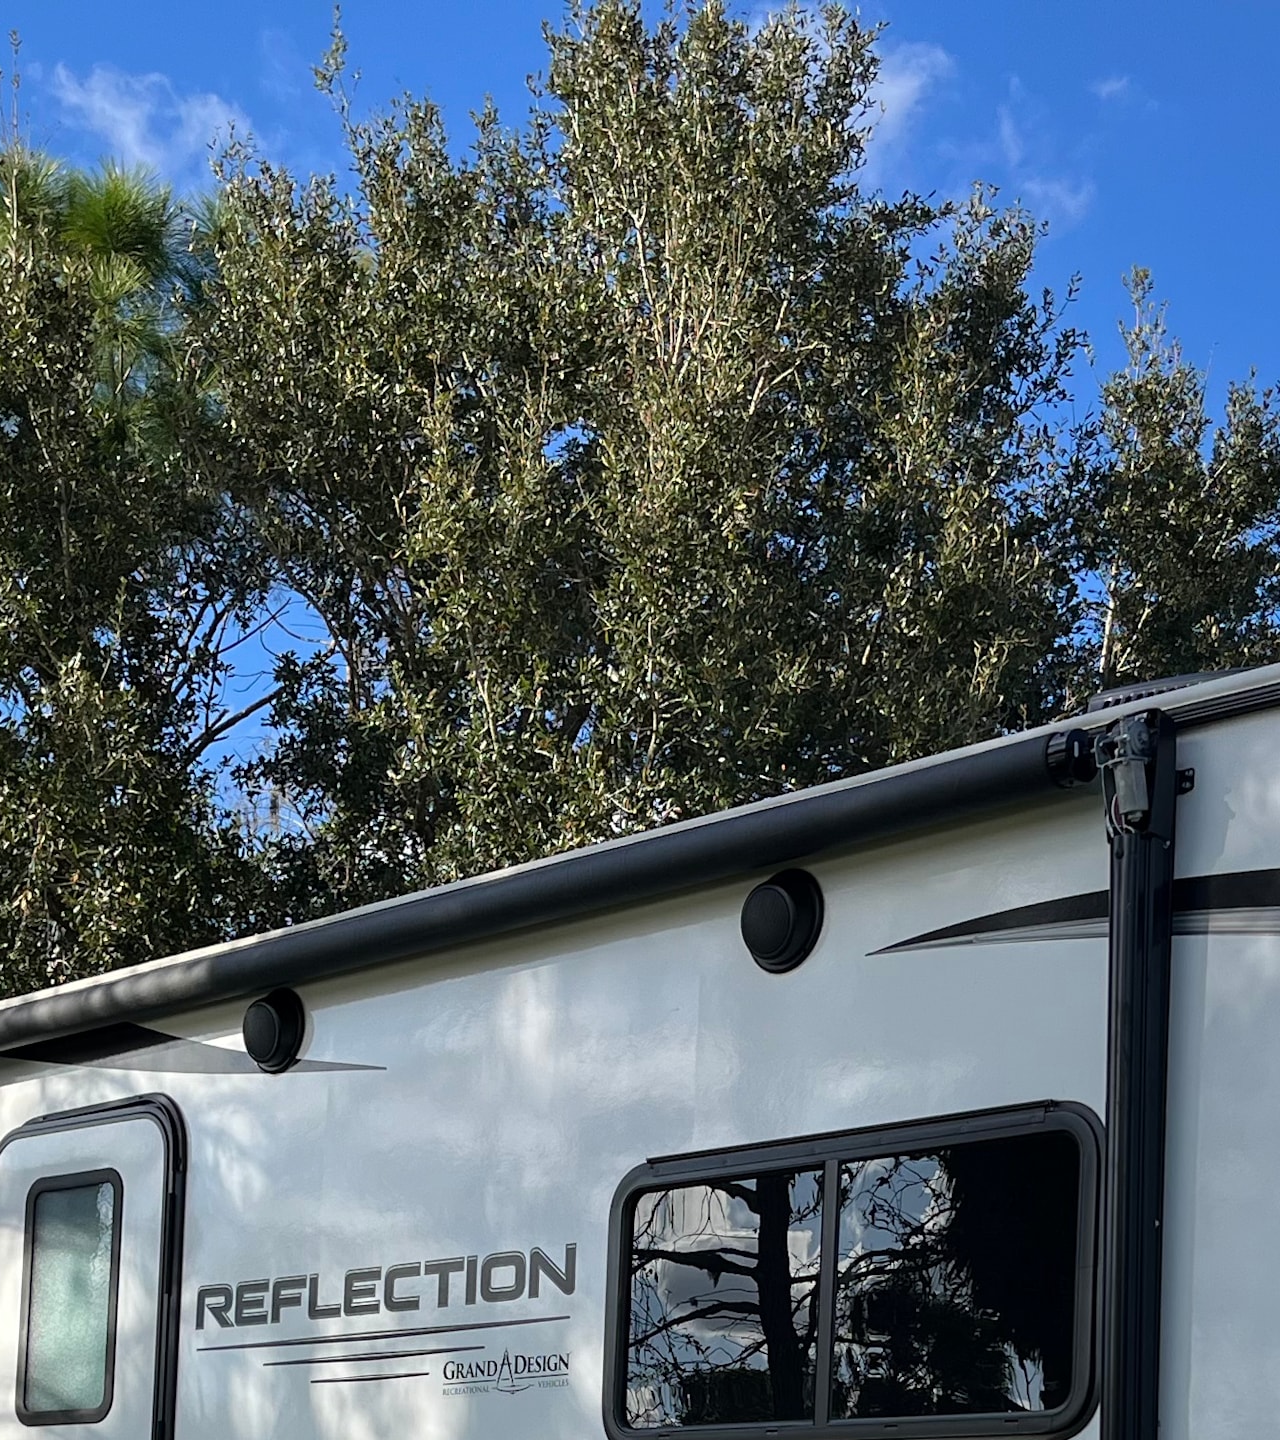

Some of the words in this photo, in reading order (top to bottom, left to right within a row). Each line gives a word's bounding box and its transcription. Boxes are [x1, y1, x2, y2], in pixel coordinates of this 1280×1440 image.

[195, 1243, 577, 1330] REFLECTION
[443, 1360, 498, 1381] GRAND
[514, 1353, 571, 1375] DESIGN
[442, 1384, 490, 1396] RECREATIONAL
[537, 1378, 569, 1389] VEHICLES
